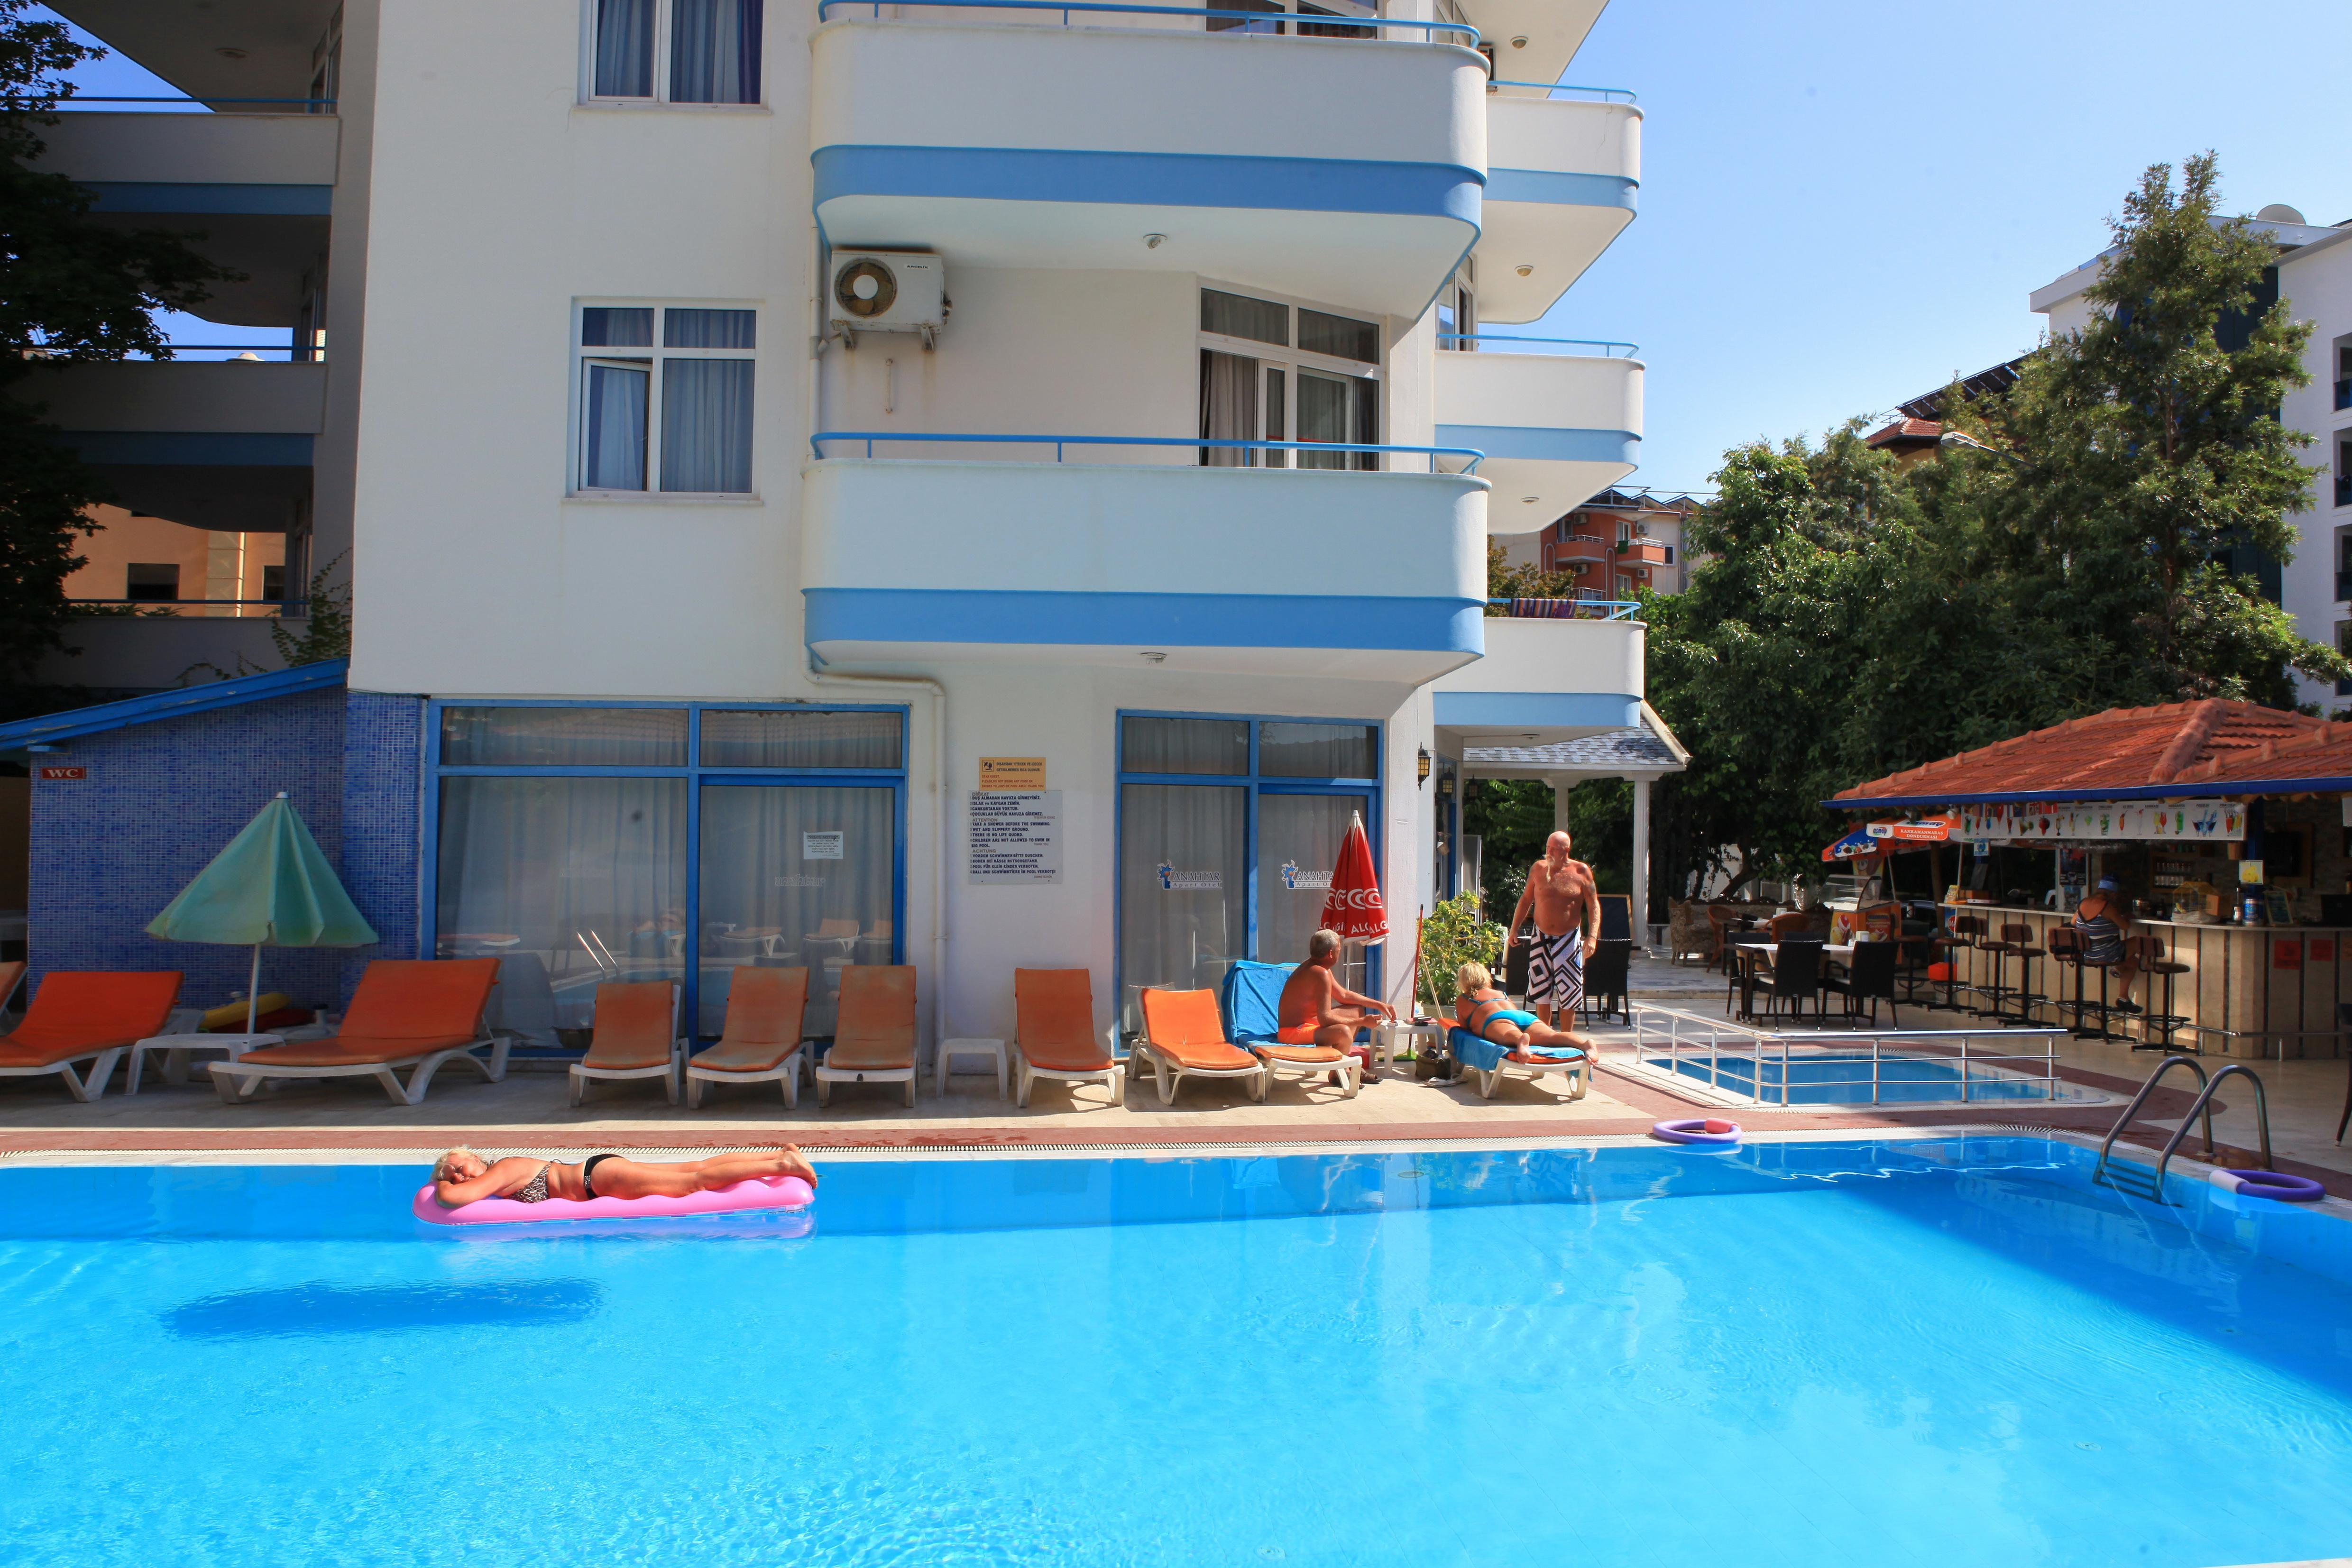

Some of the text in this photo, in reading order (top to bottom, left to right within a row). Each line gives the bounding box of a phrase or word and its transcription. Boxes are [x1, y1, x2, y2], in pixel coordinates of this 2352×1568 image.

[47, 769, 79, 778] WC
[1174, 872, 1220, 880] ANAHTAR
[1297, 871, 1333, 880] ANAHTA
